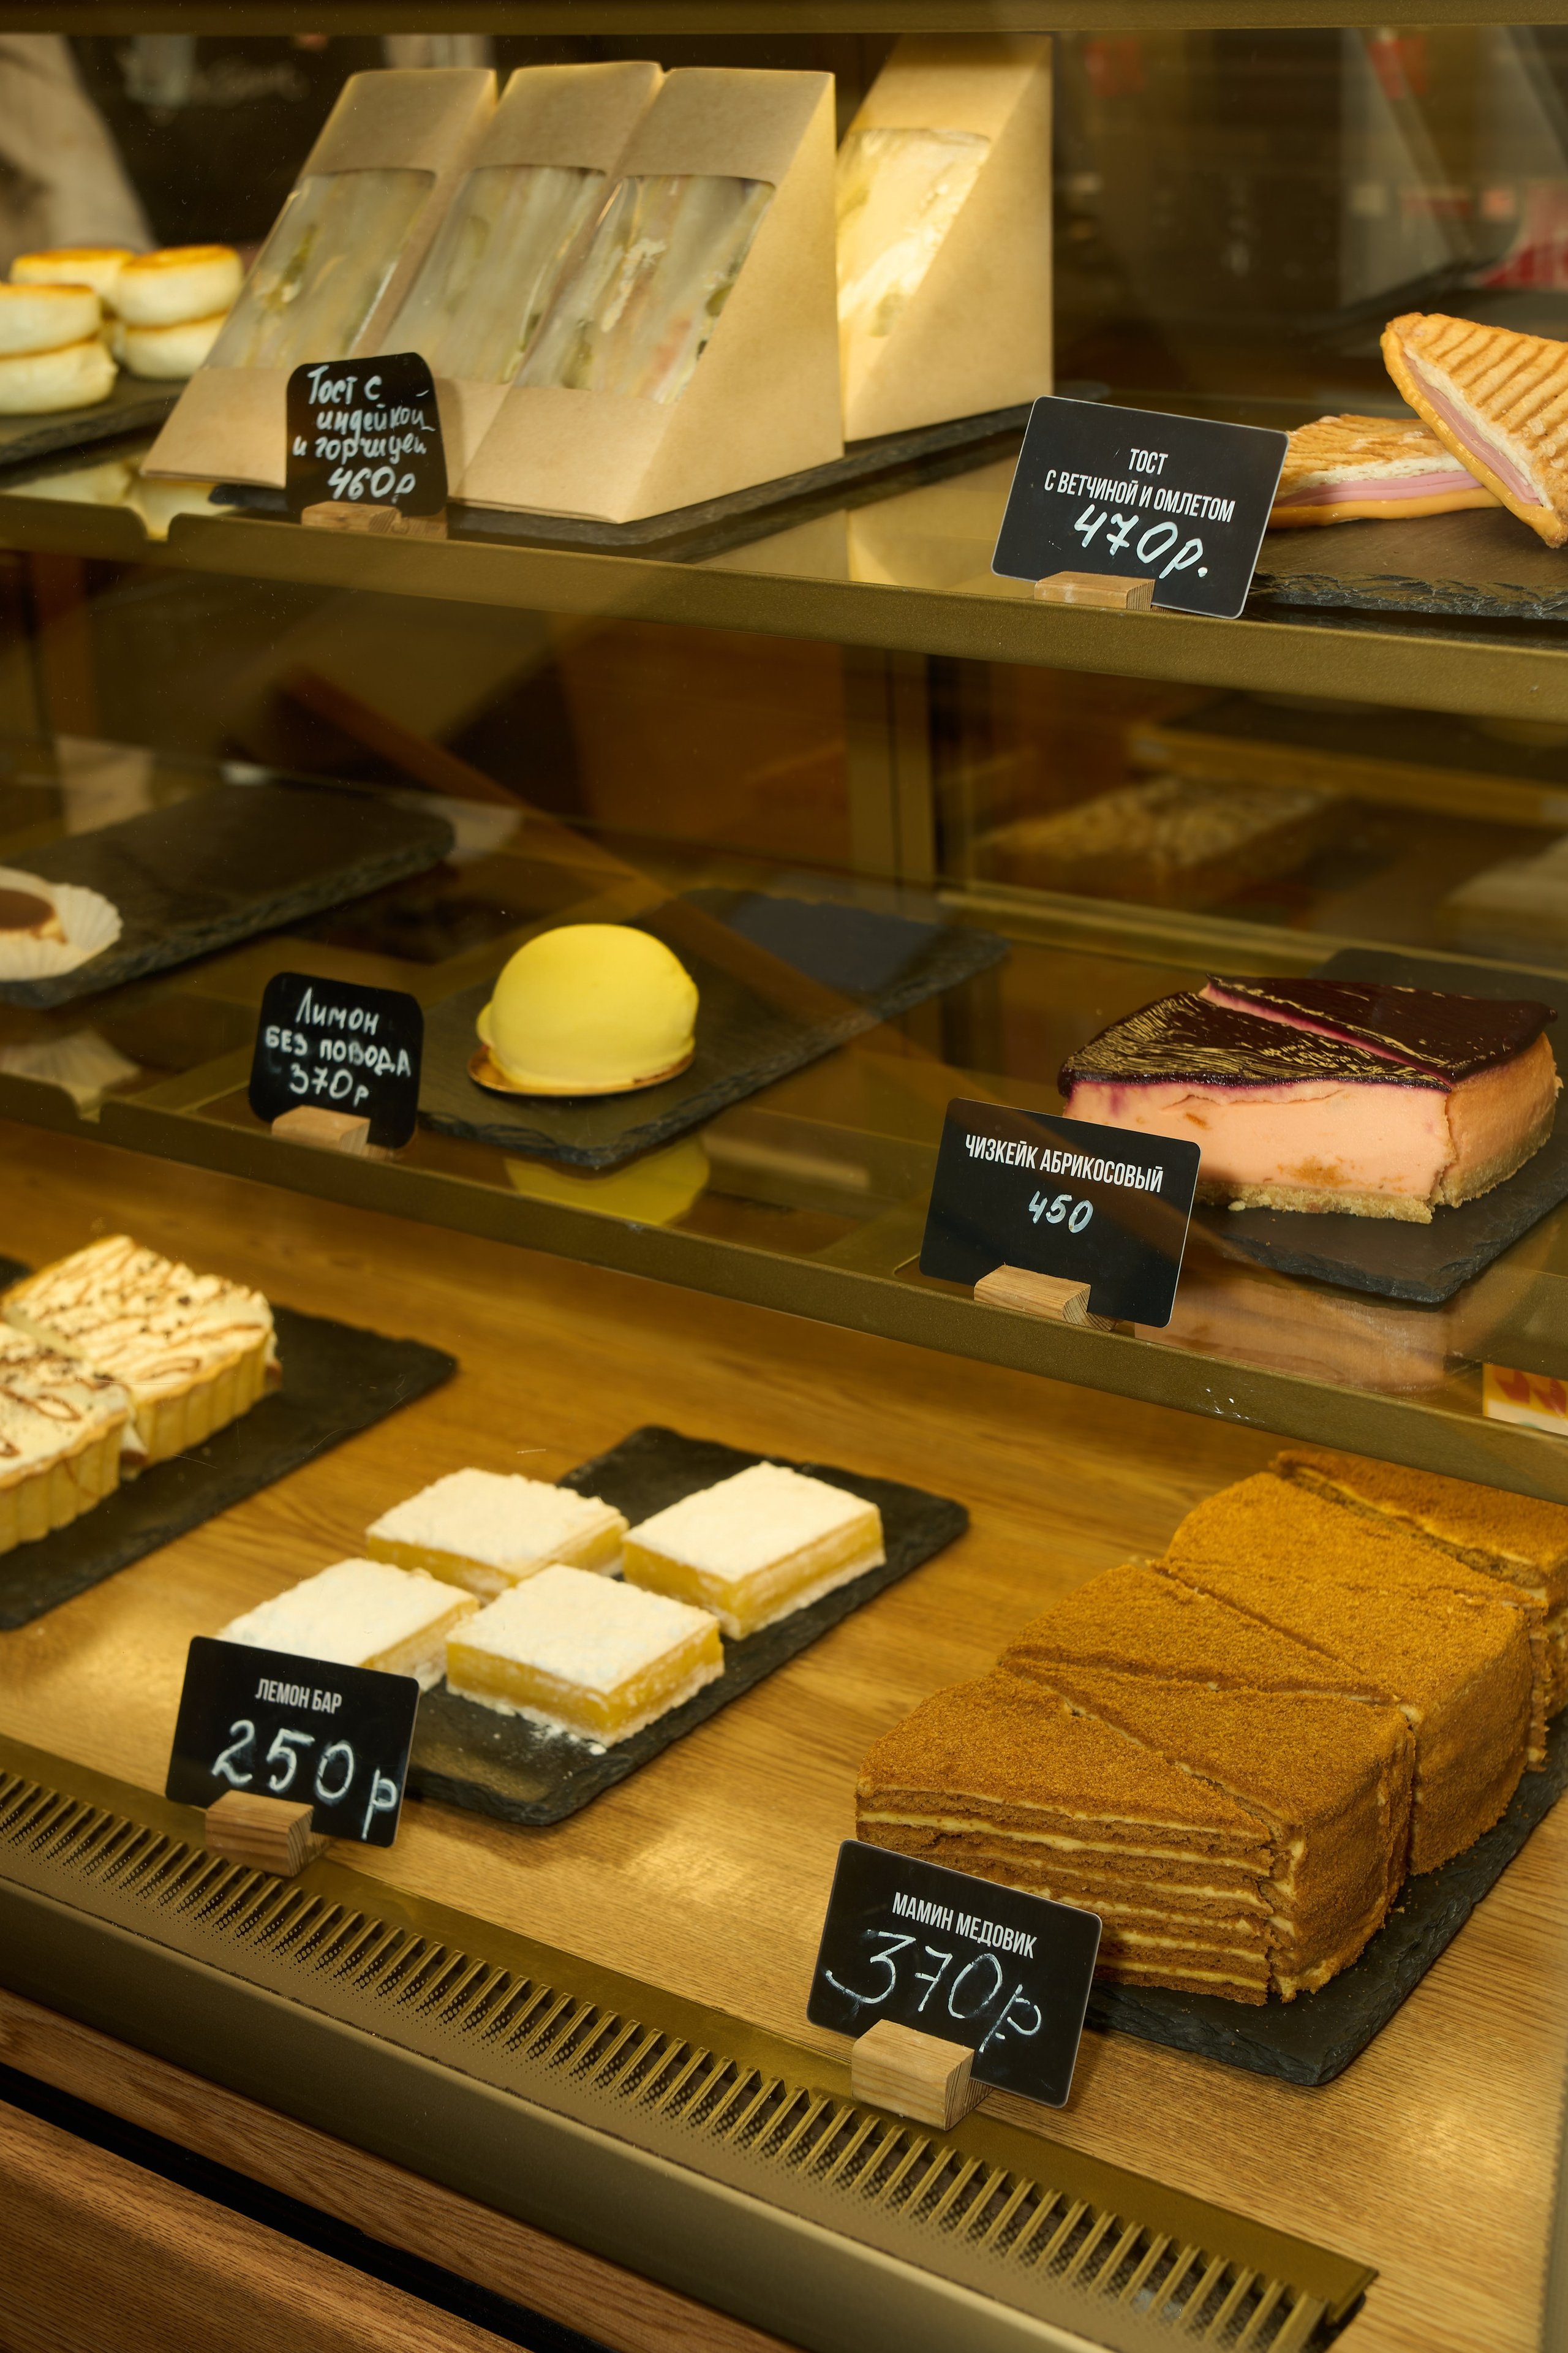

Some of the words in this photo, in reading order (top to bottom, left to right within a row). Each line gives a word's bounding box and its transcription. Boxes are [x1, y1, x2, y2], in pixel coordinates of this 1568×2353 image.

[307, 364, 358, 404] Тост
[292, 436, 307, 456] и
[1128, 448, 1169, 475] ТОСТ
[1044, 469, 1056, 491] С
[1057, 472, 1140, 507] ВЕТЧИНОЙ
[1139, 485, 1154, 508] И
[1153, 488, 1236, 523] ОМЛЕТОМ
[295, 986, 380, 1036] Лимон
[965, 1133, 1039, 1169] ЧИЗКЕЙК
[1039, 1149, 1164, 1193] АБРИКОСОВЫЙ
[1028, 1190, 1094, 1234] 450
[254, 1678, 310, 1709] ЛЕМОН
[311, 1689, 343, 1715] БАР
[892, 1891, 955, 1932] МАМИН
[956, 1912, 1038, 1959] МЕДОВИК
